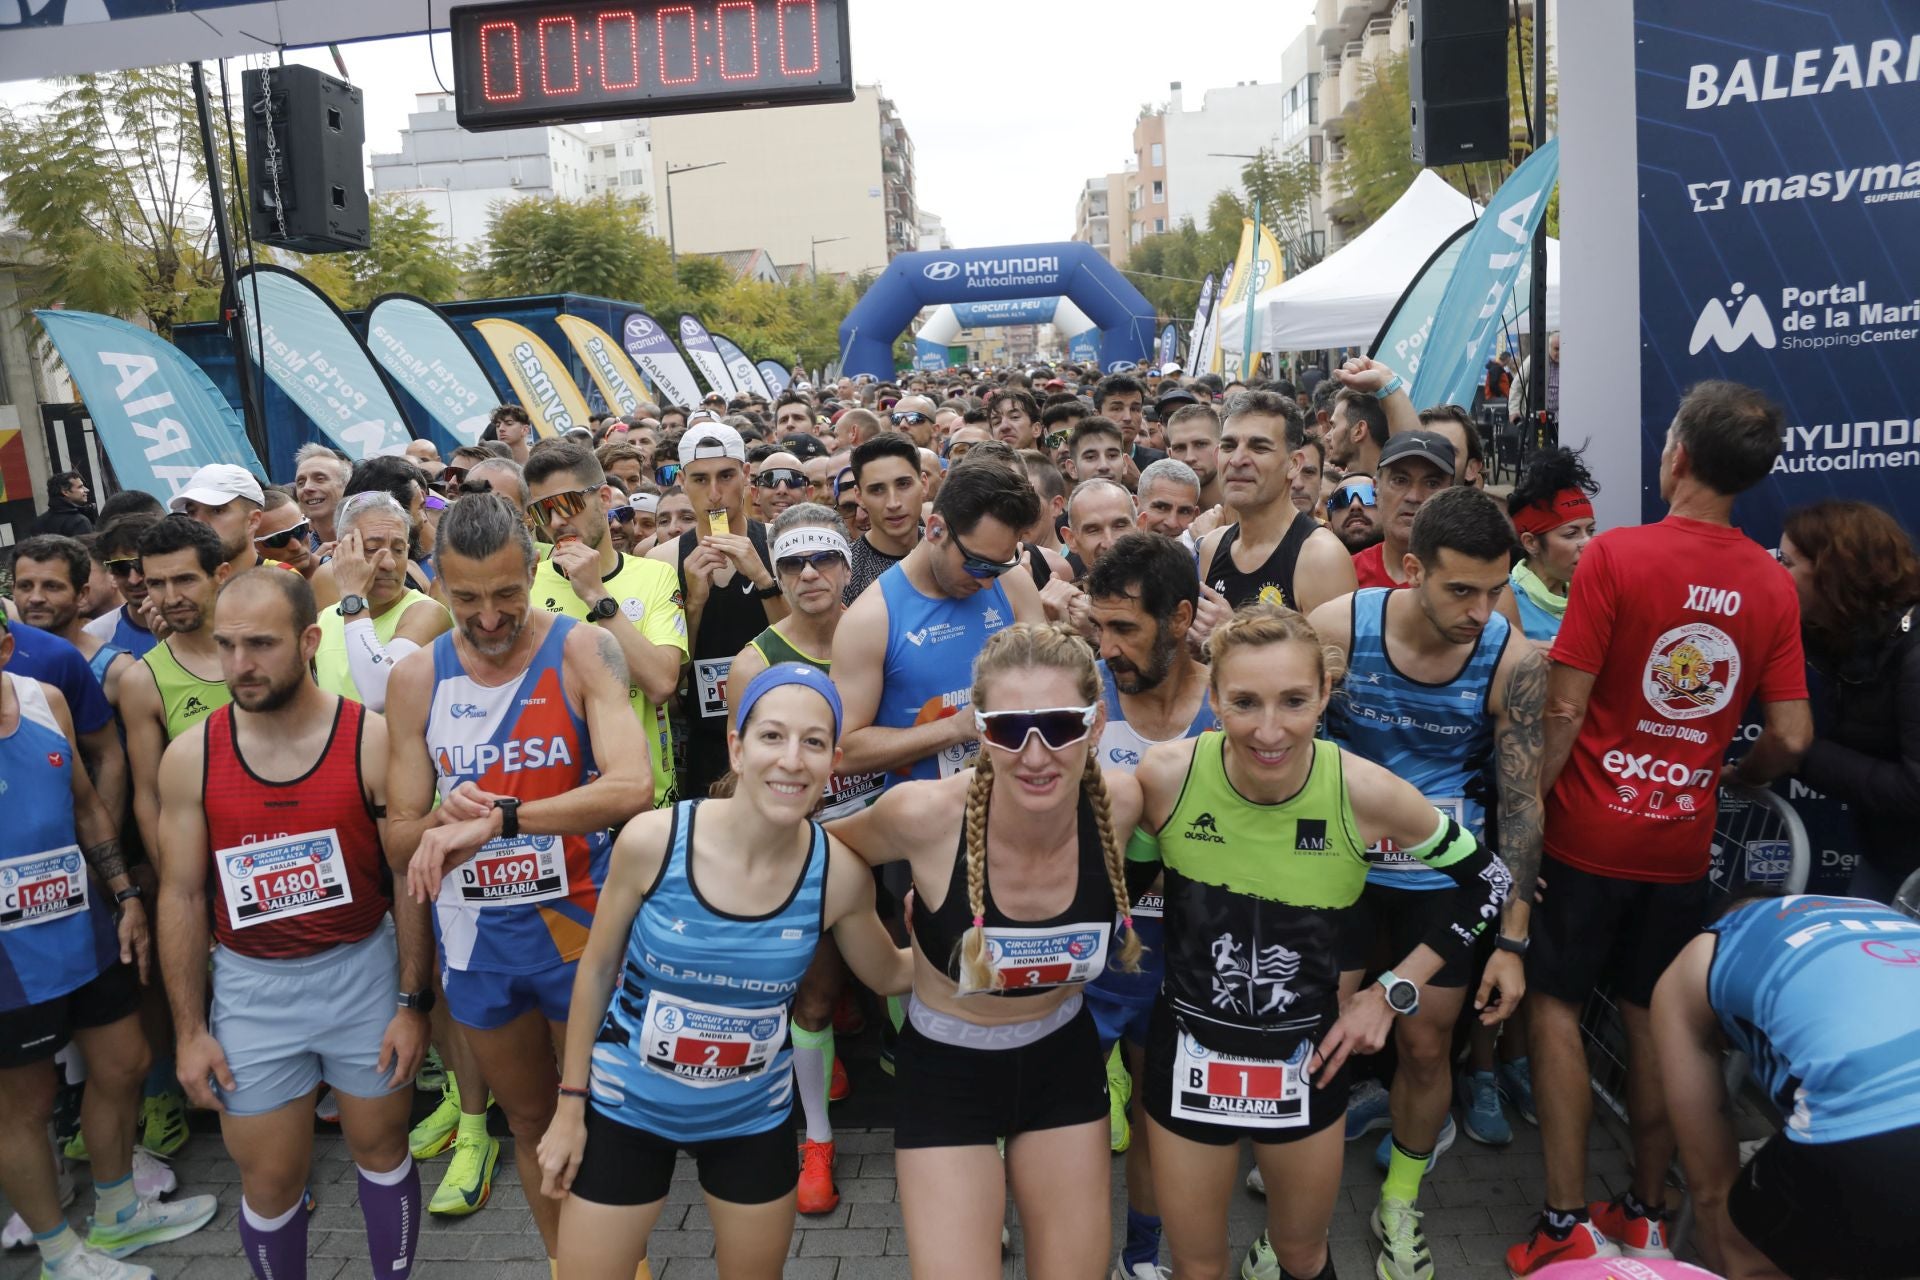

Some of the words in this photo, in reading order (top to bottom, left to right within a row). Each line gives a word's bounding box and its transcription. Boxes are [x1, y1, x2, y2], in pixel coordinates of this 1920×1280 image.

[481, 0, 819, 100] 00:00:00
[965, 256, 1059, 277] HYUNDAI
[966, 272, 1060, 289] Autoalmenar
[1782, 281, 1866, 309] Portal
[971, 301, 1010, 314] CIRCUIT
[1020, 300, 1041, 310] PEU
[1782, 310, 1817, 332] de
[1825, 307, 1850, 329] la
[1782, 327, 1919, 351] ShoppingCenter
[1683, 584, 1743, 617] XIMO
[1636, 719, 1676, 737] NUCLEO
[1675, 726, 1709, 745] DURO
[435, 736, 573, 778] ALPESA
[836, 781, 874, 802] BALEARIA
[253, 848, 282, 861] CIRCUIT
[290, 844, 306, 852] PEU
[1298, 837, 1334, 851] AMS
[462, 869, 476, 885] D
[481, 859, 535, 885] 1499
[240, 885, 253, 902] S
[259, 870, 316, 900] 1480
[483, 881, 539, 898] BALEARIA
[5, 893, 17, 909] C
[23, 881, 67, 908] 1489
[264, 891, 320, 911] ALEARIA
[21, 899, 69, 918] BALEARIA
[1004, 940, 1042, 950] CIRCUIT
[1051, 937, 1070, 947] PEU
[1010, 948, 1042, 957] MARINA
[1043, 945, 1064, 954] ALTA
[1013, 955, 1060, 966] IRONMAMI
[1025, 970, 1041, 986] 3
[686, 1012, 721, 1025] CIRCUIT
[731, 1019, 752, 1027] PEU
[690, 1021, 722, 1031] MARINA
[723, 1024, 744, 1032] ALTA
[699, 1031, 733, 1041] ANDREA
[656, 1040, 670, 1058] S
[703, 1045, 721, 1067] 2
[673, 1063, 741, 1080] BALEARIA
[1189, 1067, 1204, 1089] B
[1238, 1071, 1249, 1097] 1
[1208, 1096, 1279, 1114] BALEARIA
[398, 1194, 412, 1257] COMPRESSPORT
